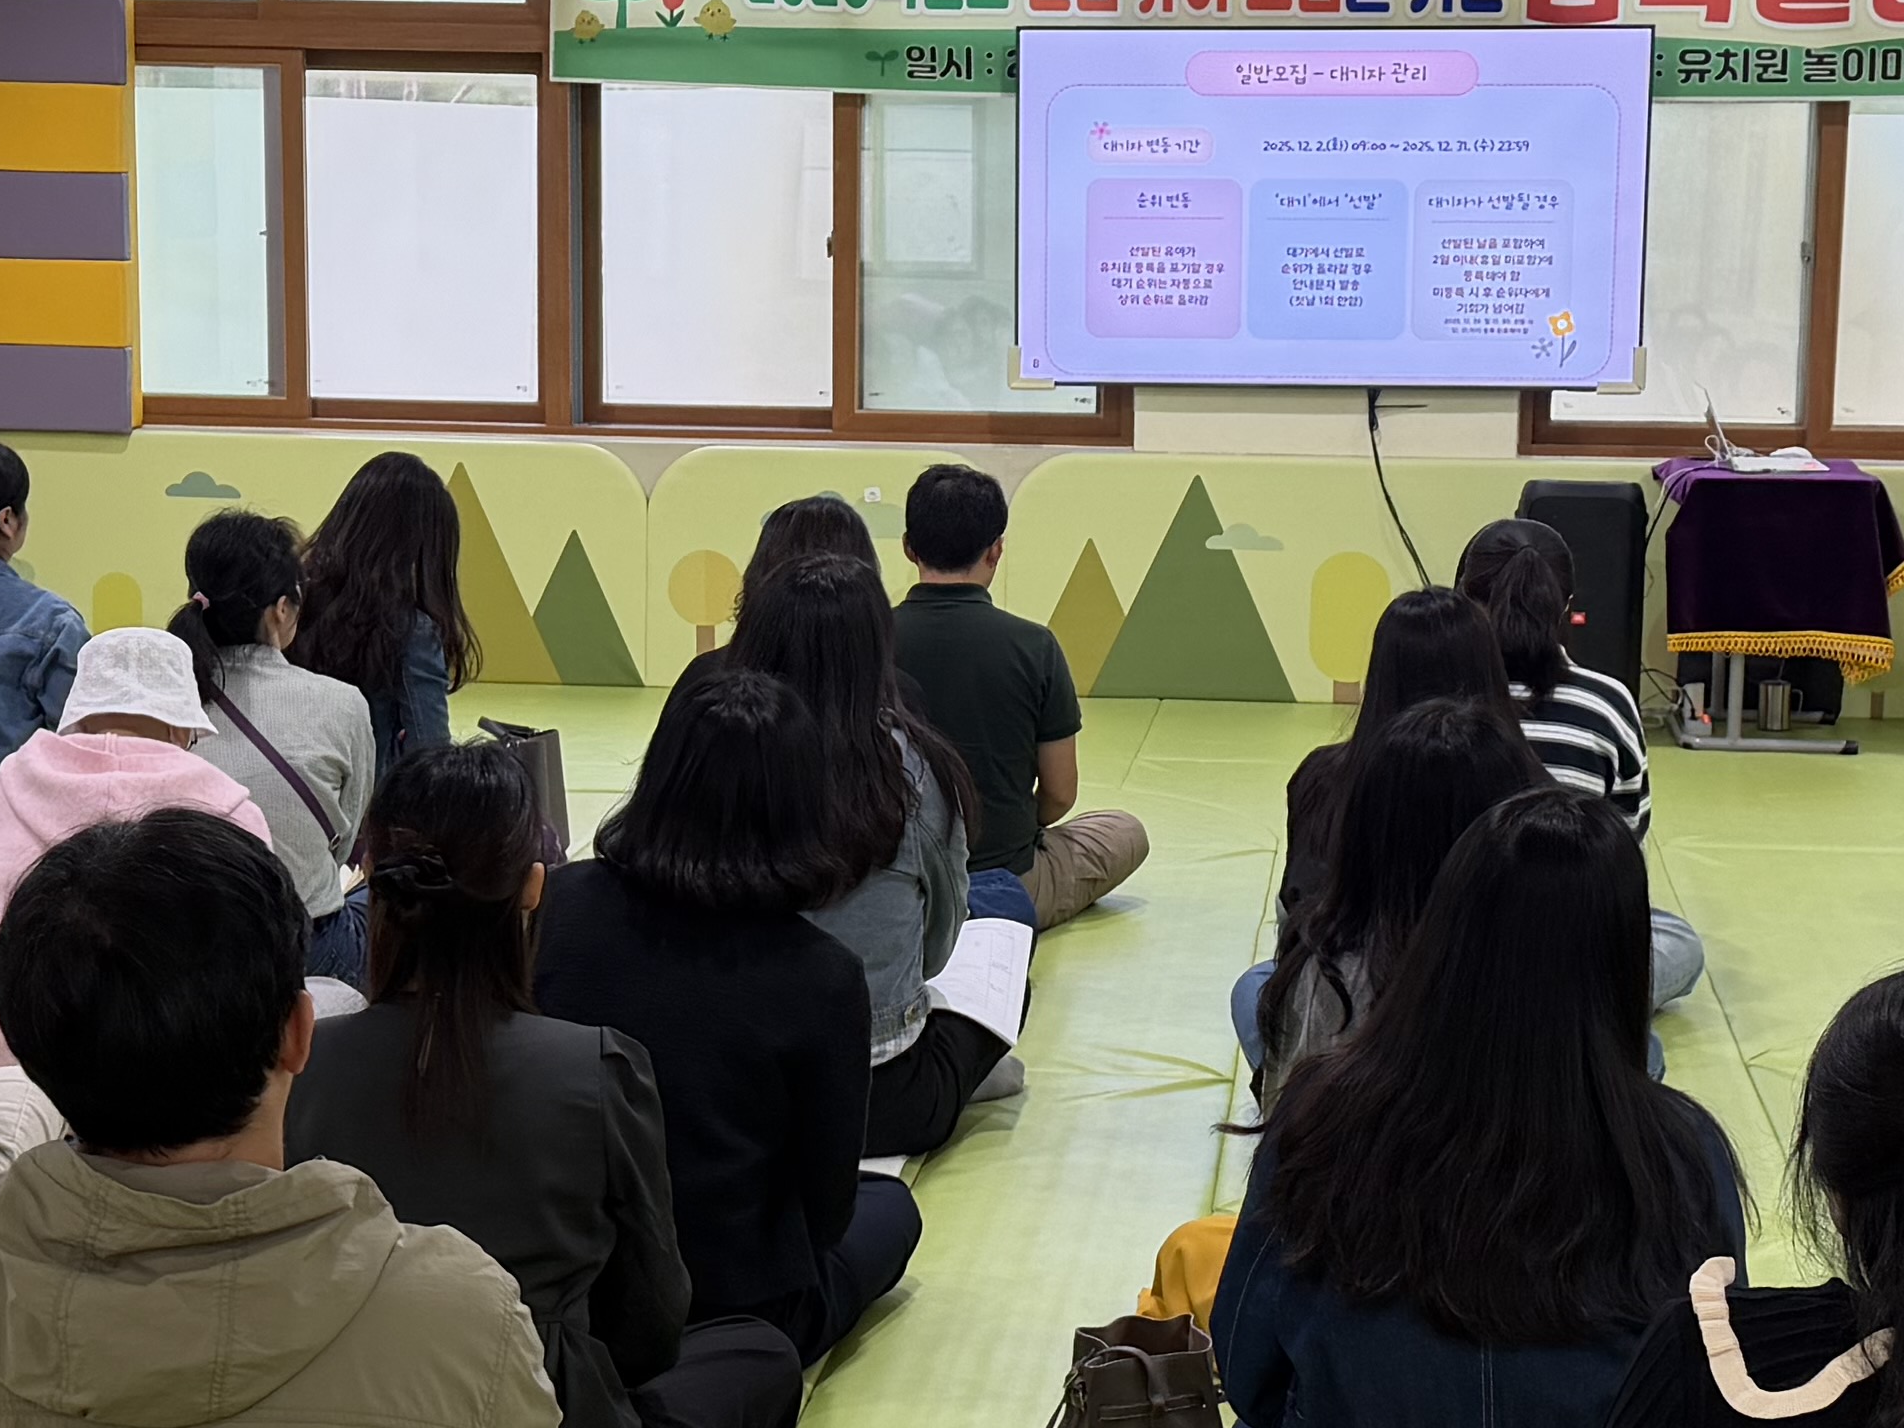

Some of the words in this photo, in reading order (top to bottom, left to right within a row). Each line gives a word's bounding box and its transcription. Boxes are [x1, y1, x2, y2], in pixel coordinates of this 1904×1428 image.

[905, 45, 973, 80] 일시
[1677, 47, 1789, 84] 유치원
[1235, 62, 1308, 85] 일반모집
[1329, 64, 1387, 82] 대기자
[1391, 62, 1427, 83] 관리
[1103, 139, 1144, 152] 대기자
[1146, 136, 1172, 154] 변동
[1174, 138, 1201, 154] 기간
[1351, 140, 1387, 152] 09:00
[1497, 140, 1530, 152] 23:59
[1136, 192, 1163, 209] 순위
[1165, 192, 1192, 209] 변동
[1428, 195, 1484, 209] 대기자가
[1487, 192, 1531, 211] 선발될
[1534, 194, 1560, 210] 경우
[1501, 238, 1546, 250] 포함하여
[1134, 261, 1166, 274] 등록을
[1204, 263, 1225, 274] 경우
[1281, 263, 1313, 275] 순위가
[1111, 278, 1133, 289] 대기
[1135, 278, 1168, 290] 순위는
[1169, 278, 1213, 290] 자동으로
[1142, 294, 1174, 306] 순위로
